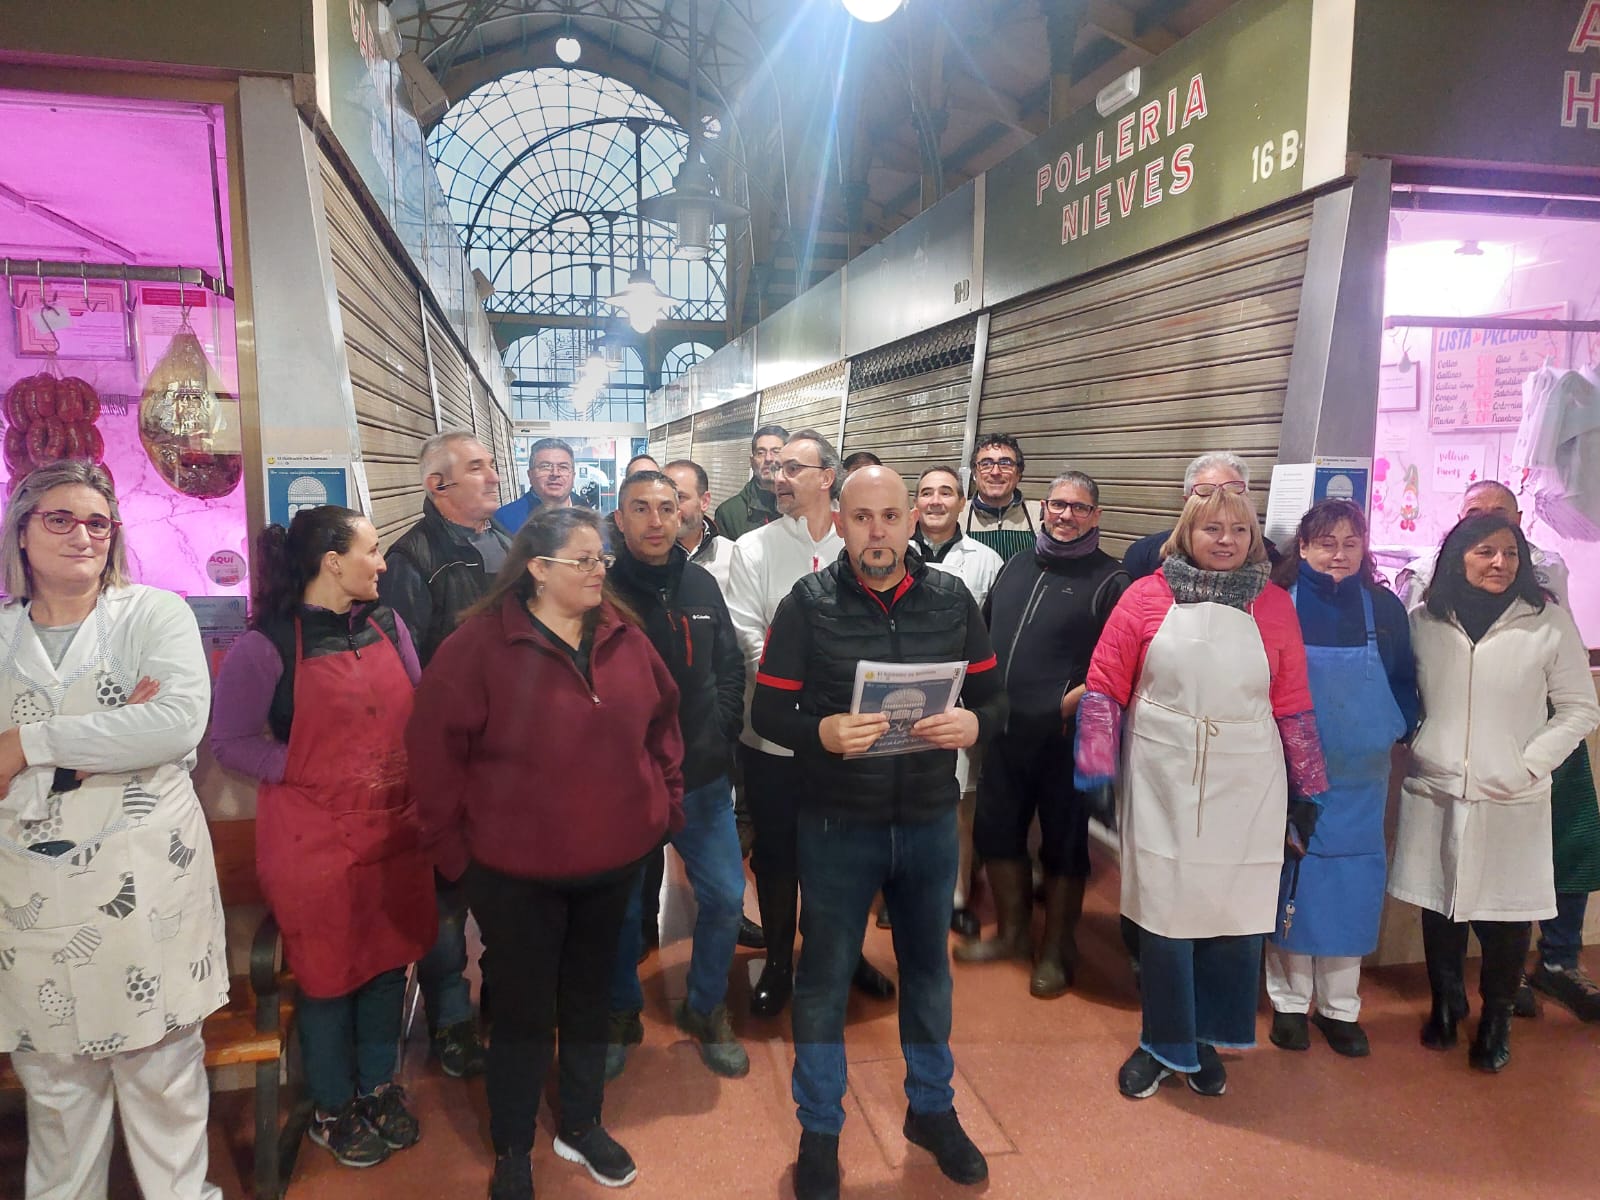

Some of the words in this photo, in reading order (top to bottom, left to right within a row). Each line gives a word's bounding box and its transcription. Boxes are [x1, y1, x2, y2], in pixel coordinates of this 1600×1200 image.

[1037, 73, 1208, 206] POLLERIA
[1251, 139, 1276, 184] 16
[1280, 129, 1300, 171] B
[1061, 143, 1195, 246] NIEVES
[1438, 328, 1473, 352] LISTA
